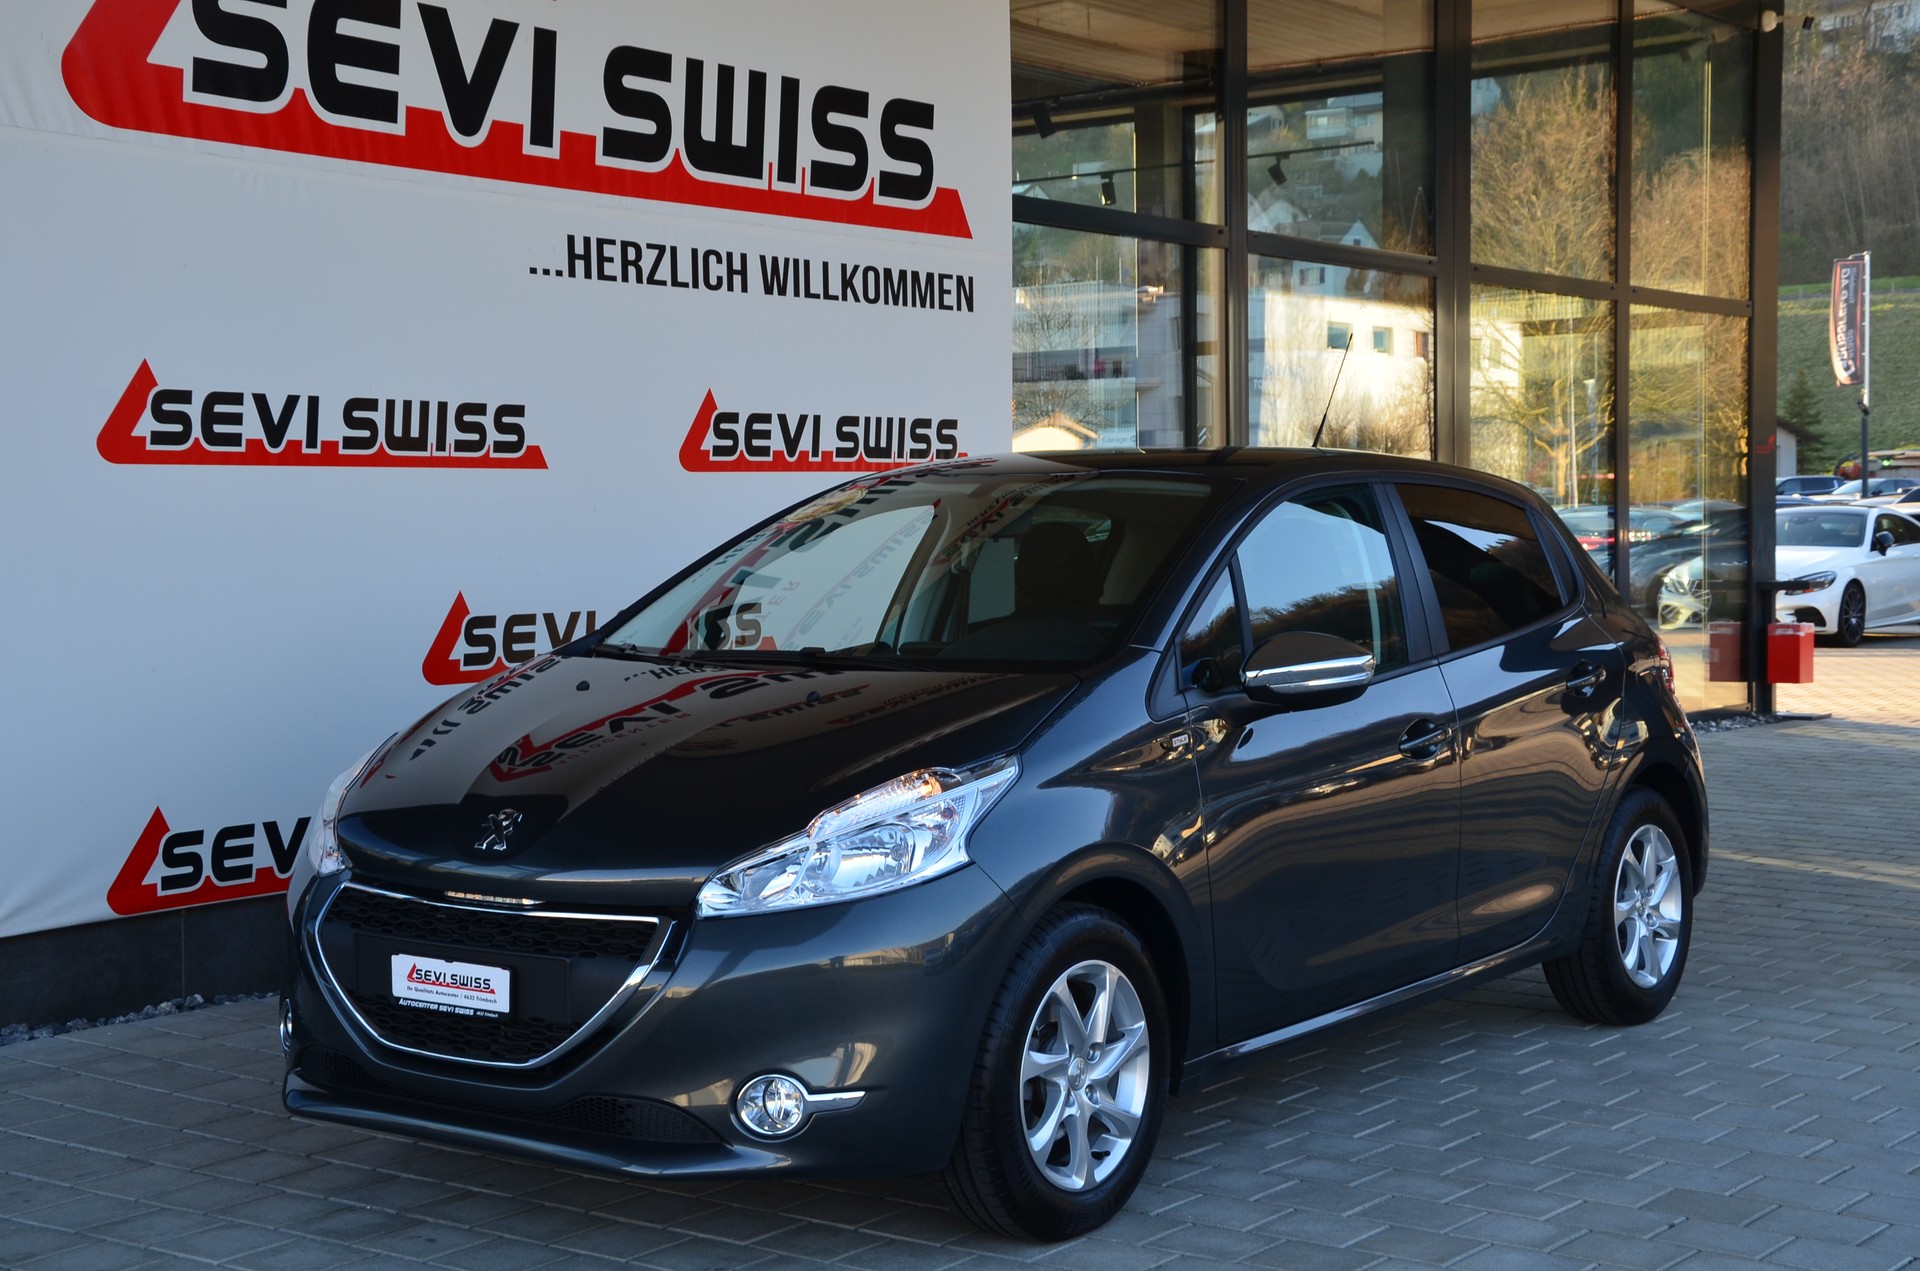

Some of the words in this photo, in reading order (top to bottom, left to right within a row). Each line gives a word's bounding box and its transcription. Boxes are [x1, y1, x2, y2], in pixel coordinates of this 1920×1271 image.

[192, 0, 558, 149] SEVI
[602, 45, 936, 202] SWISS
[759, 254, 974, 313] WILLKOMMEN
[149, 388, 320, 449] SEVI
[342, 397, 526, 454] SWISS
[712, 411, 821, 458] SEVI
[835, 415, 958, 460] SWISS
[161, 816, 312, 892] SEV
[415, 968, 446, 983] SEVI
[450, 974, 491, 990] SWISS
